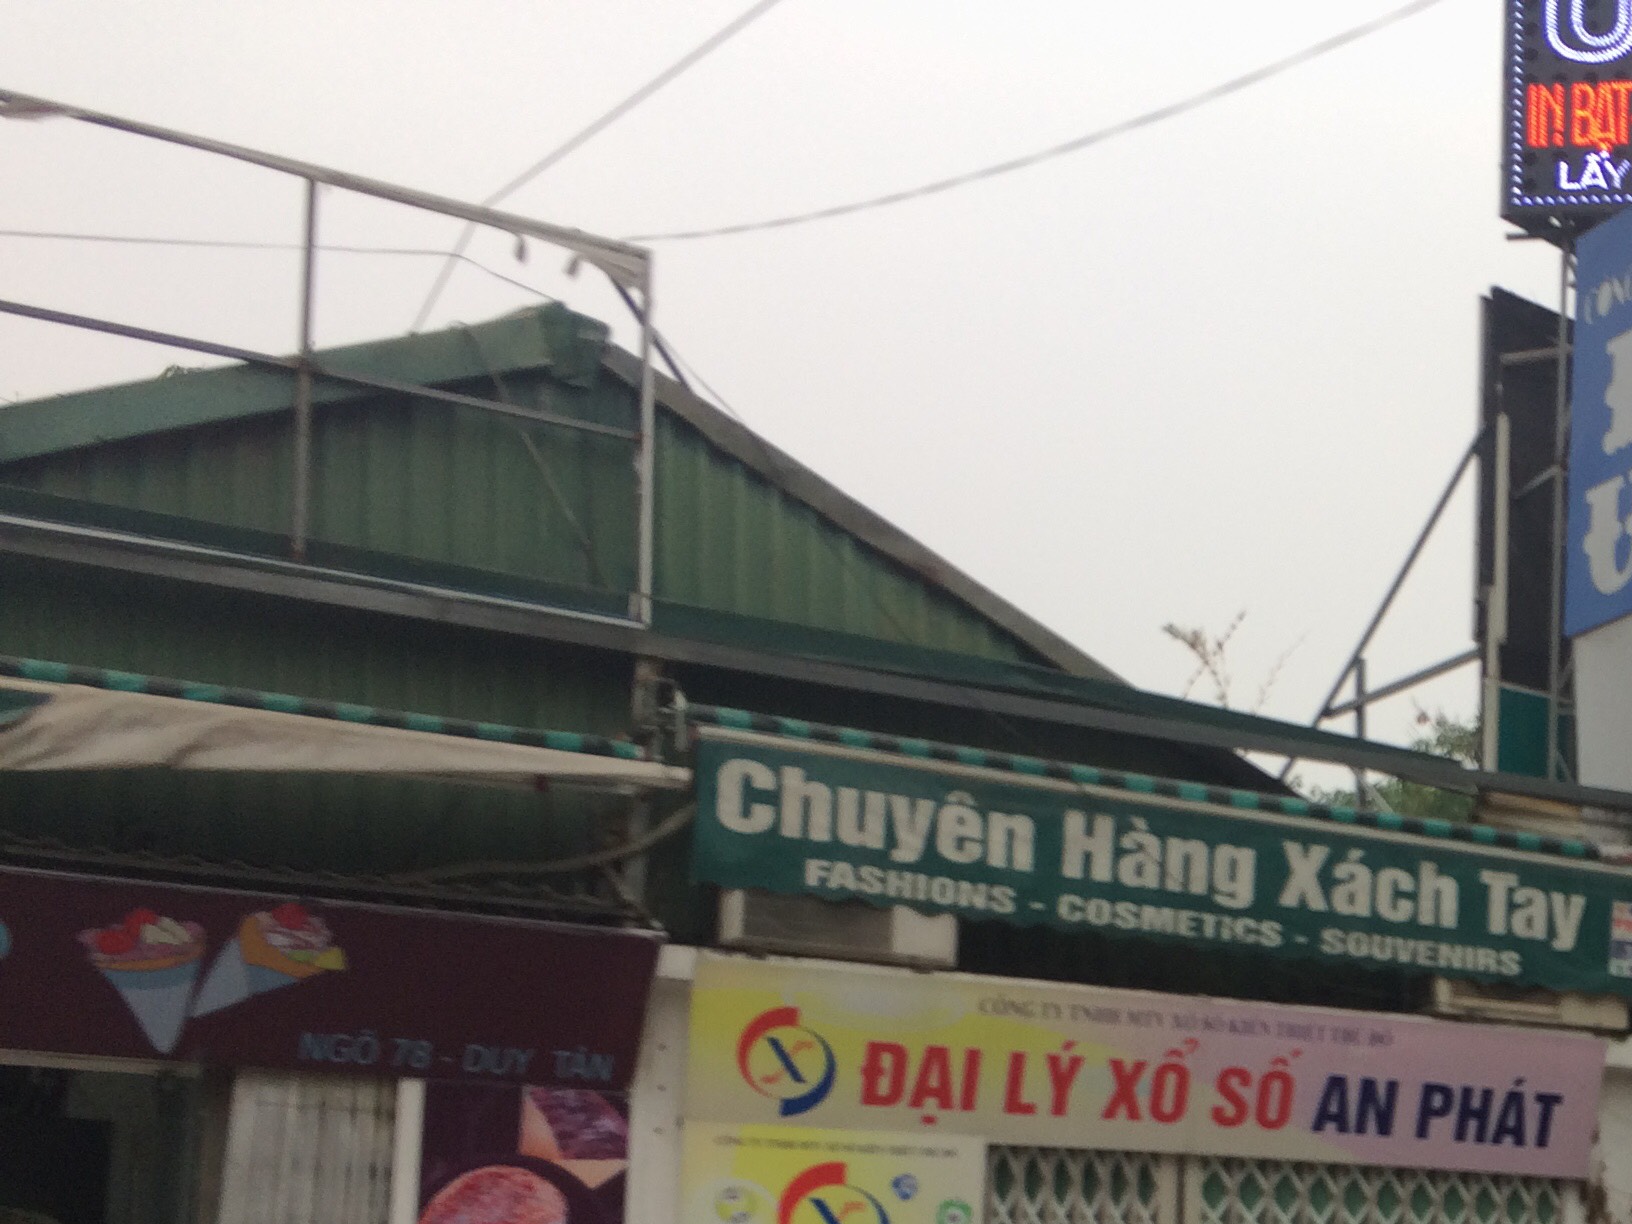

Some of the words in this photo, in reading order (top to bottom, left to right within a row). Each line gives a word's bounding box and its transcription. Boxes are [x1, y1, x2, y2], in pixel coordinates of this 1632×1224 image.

[714, 757, 1037, 874] Chuyên
[1061, 806, 1257, 911] Hàng
[1277, 838, 1460, 932] Xách
[1479, 866, 1588, 953] Tay
[804, 857, 1017, 915] FASHIONS
[1057, 894, 1283, 948] COSMETICS
[1319, 926, 1523, 977] SOUVENIRS
[462, 1042, 535, 1076] DUY
[860, 1039, 984, 1126] ĐẠI
[1003, 1039, 1085, 1117] LÝ
[1102, 1037, 1199, 1123] XỔ
[1210, 1047, 1303, 1131] SỐ
[1311, 1072, 1400, 1138] AN
[1415, 1076, 1564, 1148] PHÁT
